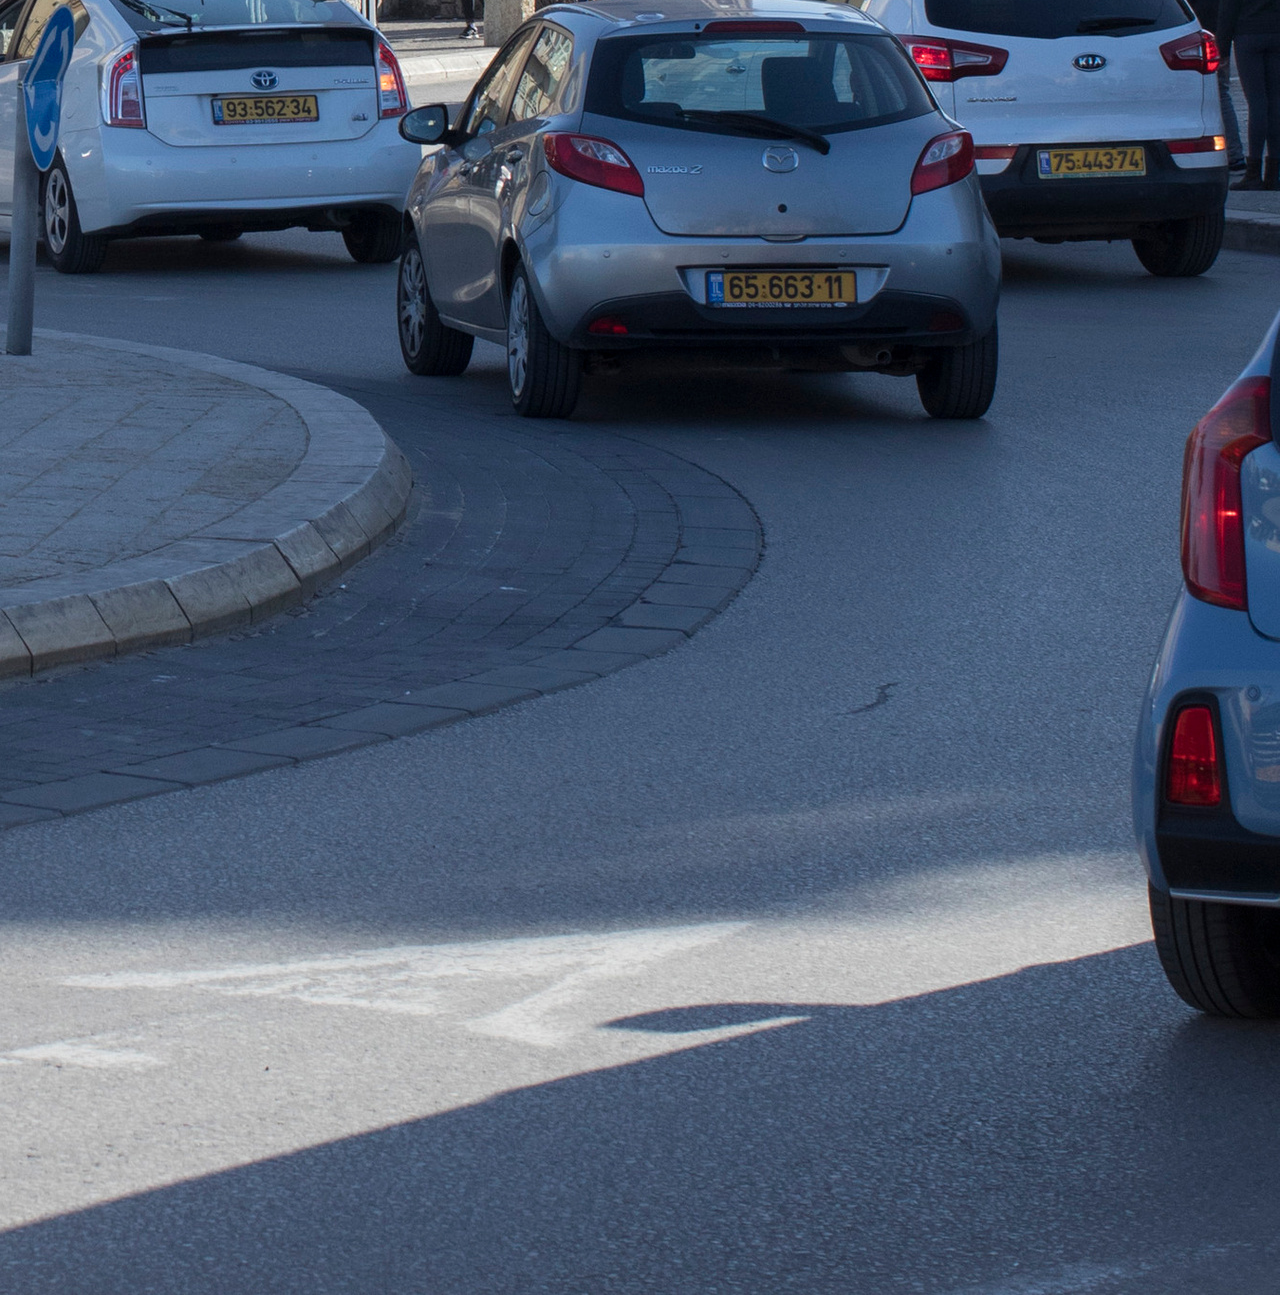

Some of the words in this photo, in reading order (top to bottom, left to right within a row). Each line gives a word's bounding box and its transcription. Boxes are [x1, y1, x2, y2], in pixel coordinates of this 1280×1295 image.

[1078, 56, 1102, 65] KIA
[647, 164, 688, 174] mazda
[689, 164, 703, 174] 2
